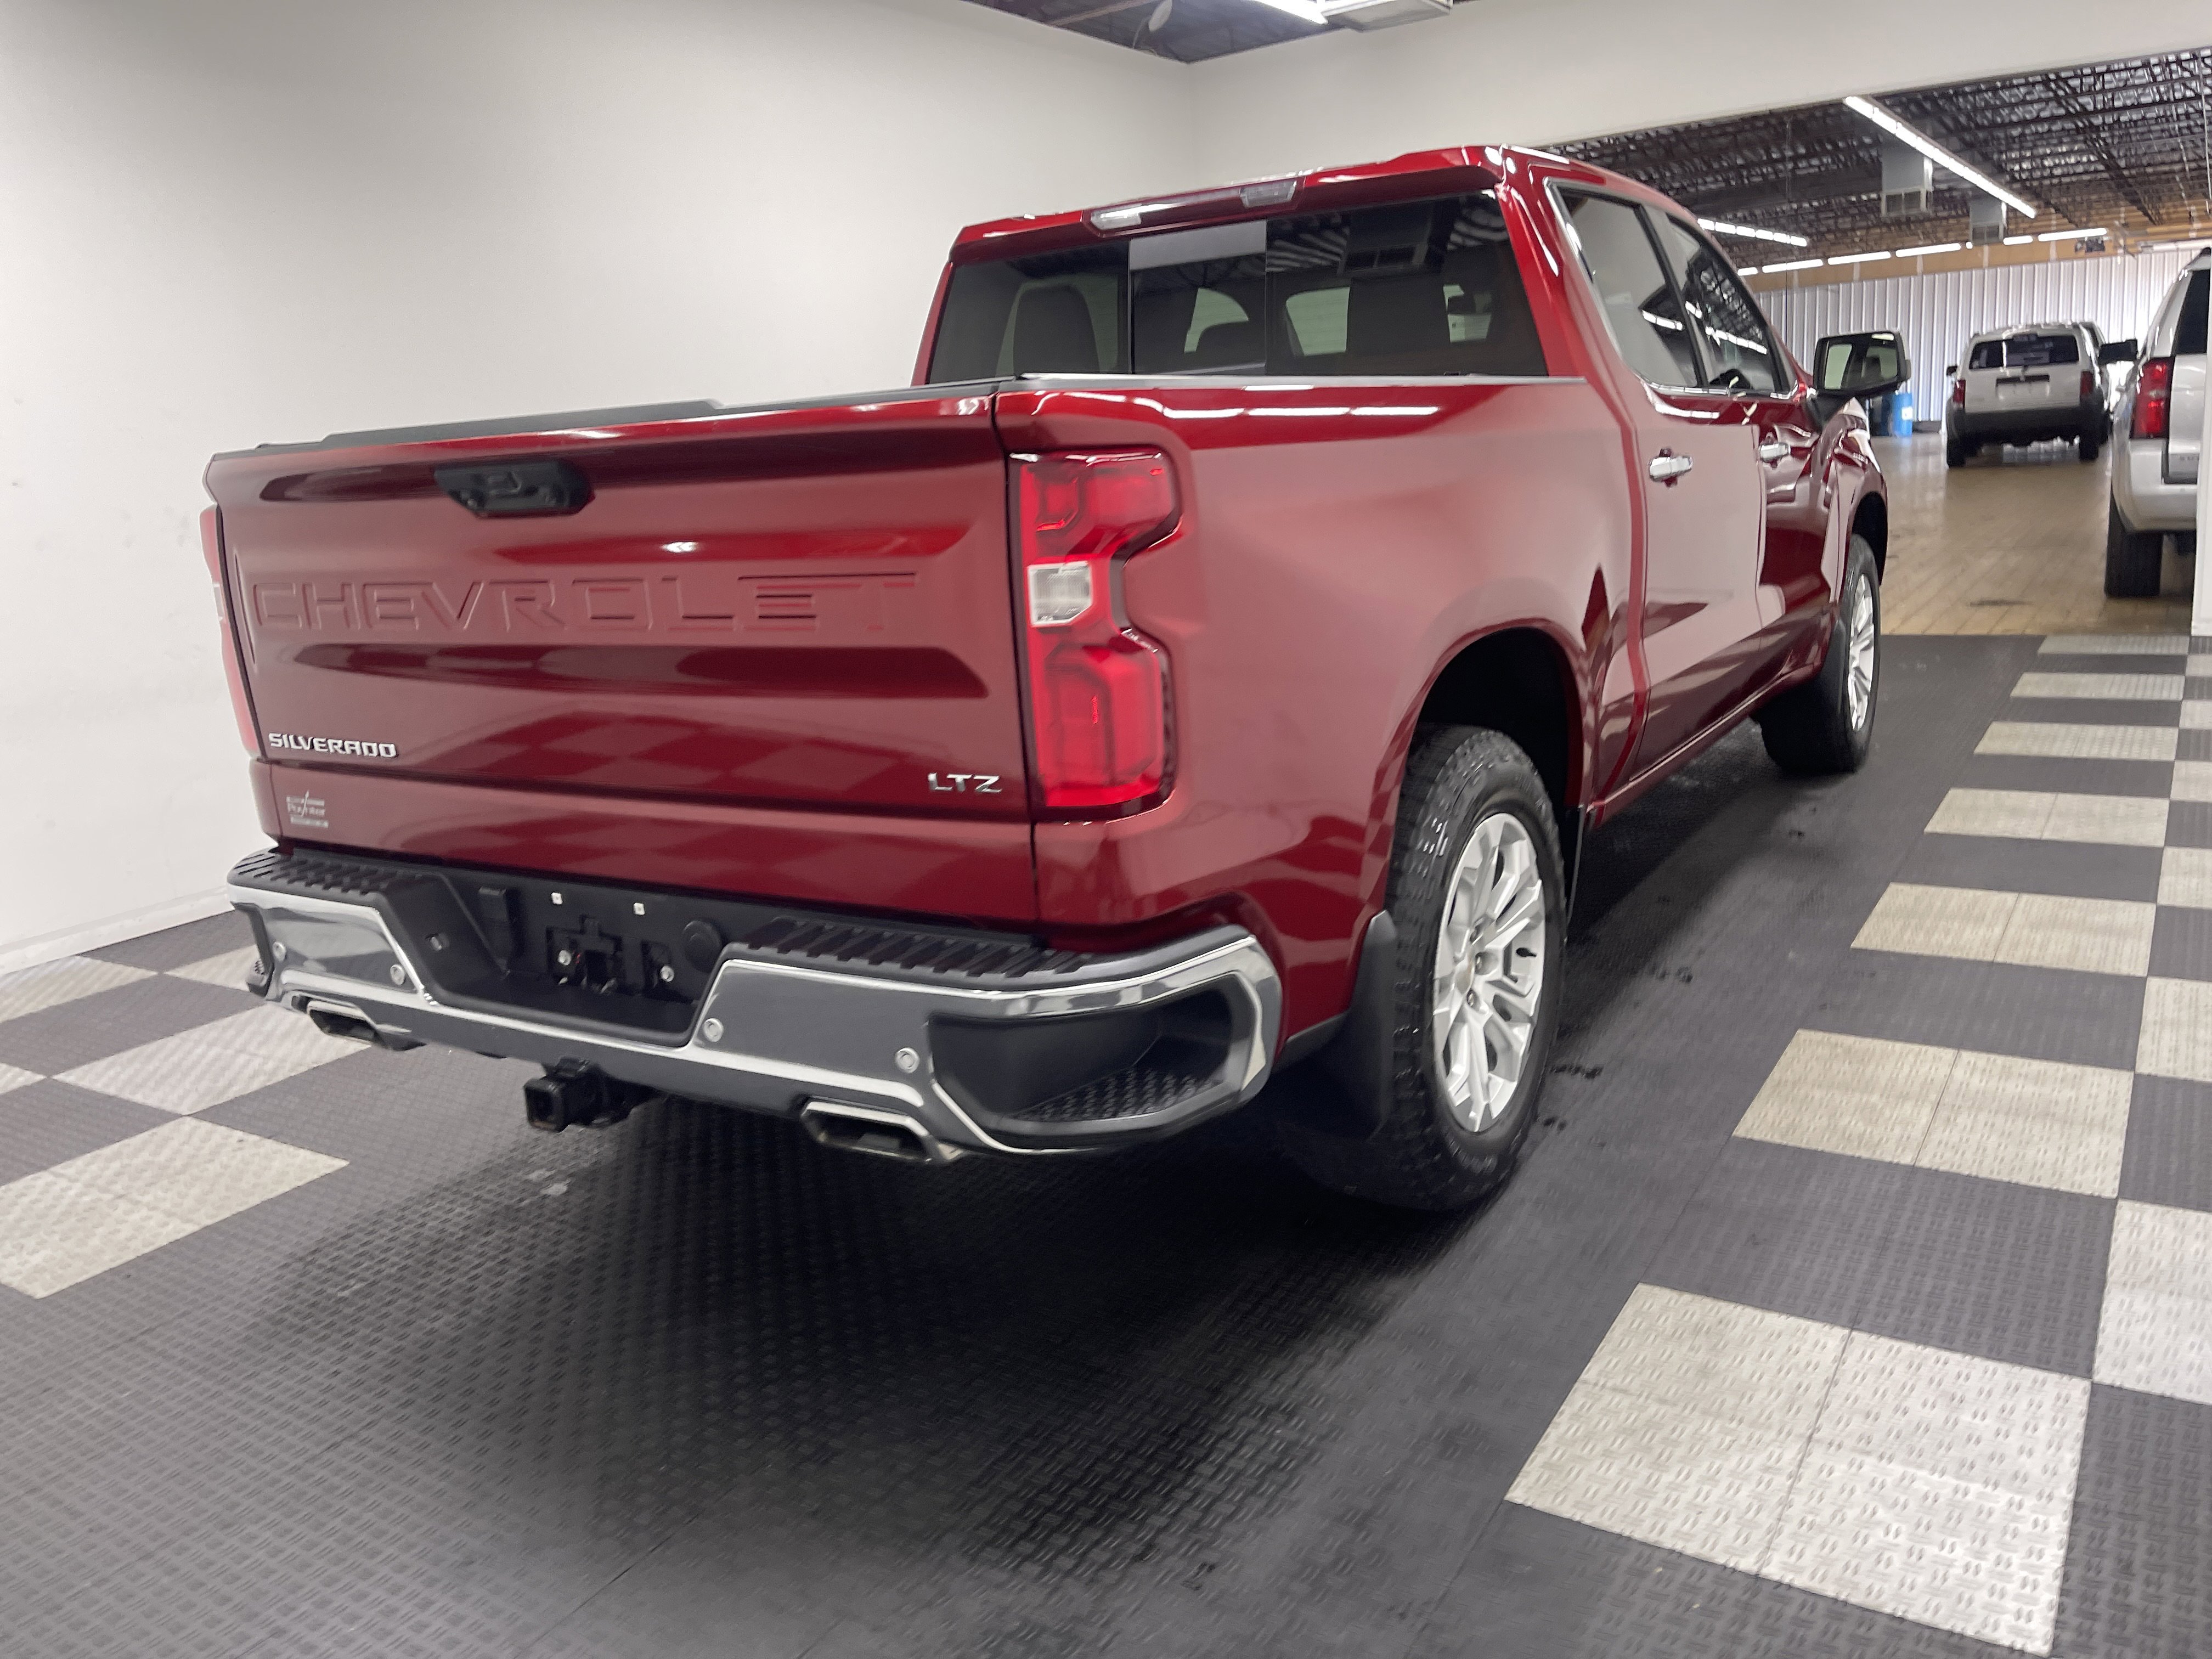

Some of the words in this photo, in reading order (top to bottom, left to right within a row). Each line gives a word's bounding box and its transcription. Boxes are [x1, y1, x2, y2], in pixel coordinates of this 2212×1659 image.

[252, 572, 917, 631] CHEVROLET
[268, 732, 397, 758] SILVERADO
[927, 772, 1003, 793] LTZ
